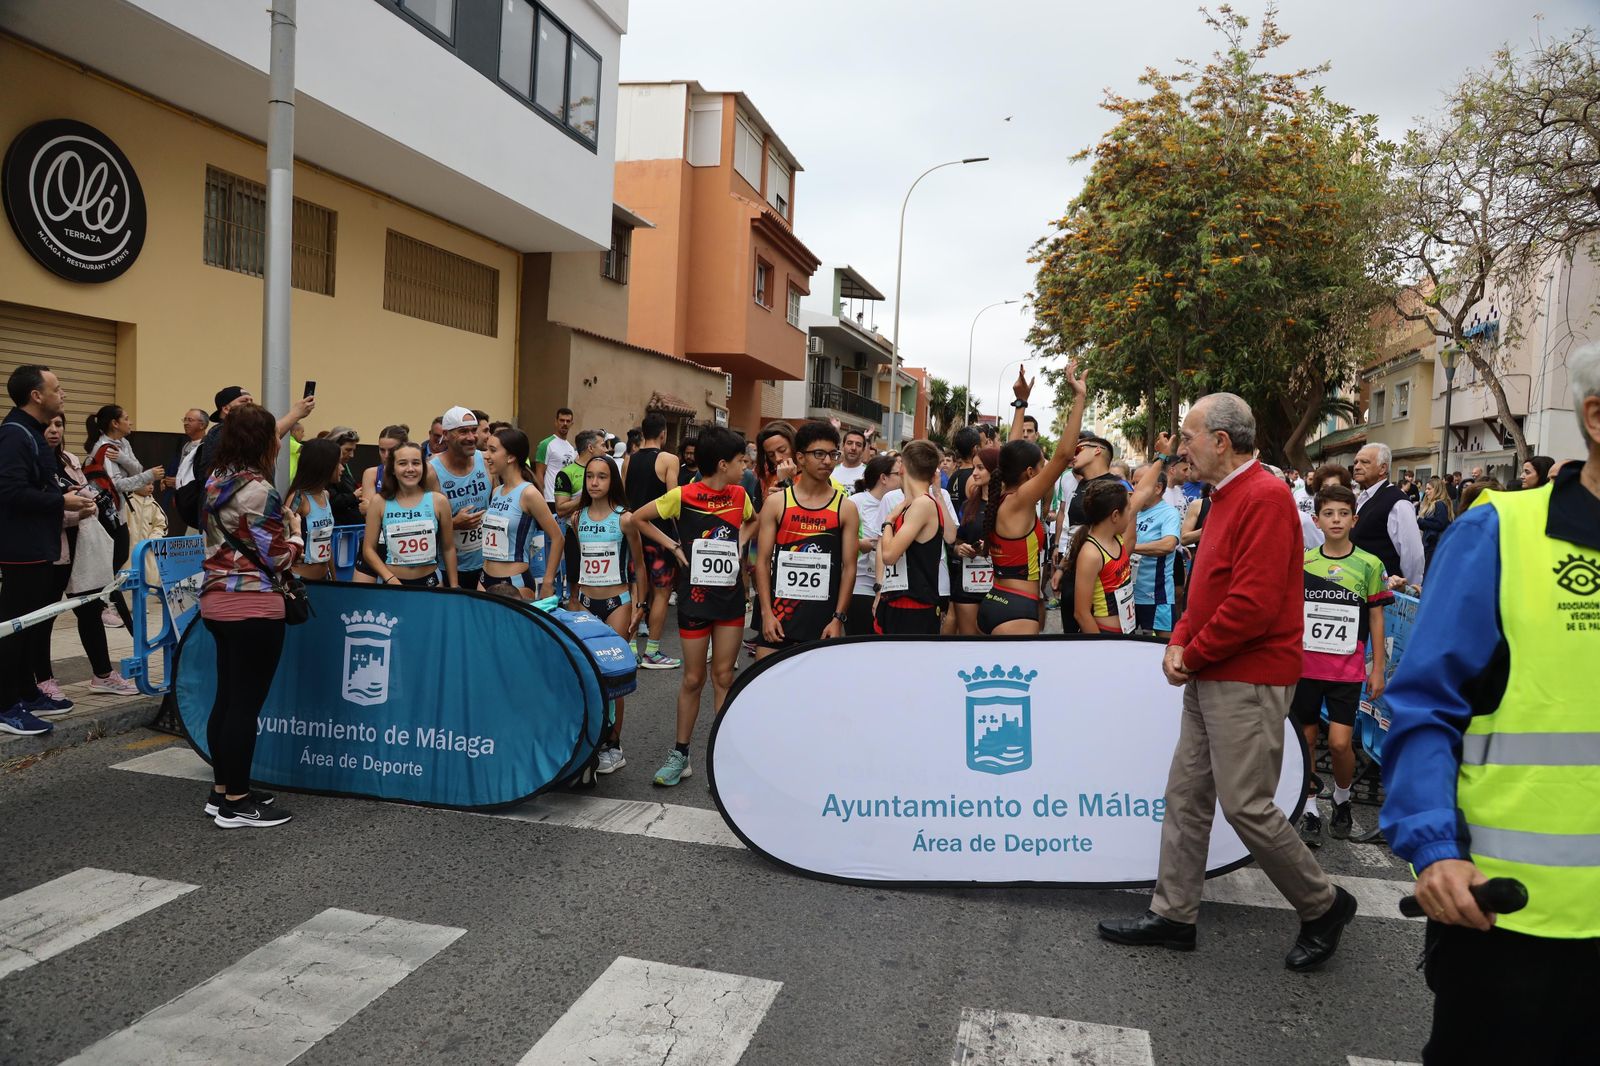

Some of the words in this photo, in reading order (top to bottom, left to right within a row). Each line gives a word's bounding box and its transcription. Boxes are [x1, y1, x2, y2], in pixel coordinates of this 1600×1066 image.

[43, 150, 118, 235] Olé
[64, 228, 101, 243] TERRAZA
[37, 230, 61, 257] MÁLAGA
[66, 257, 106, 270] RESTAURANT
[110, 249, 129, 266] EVENTS
[446, 480, 487, 499] nerja
[312, 517, 332, 527] nerja
[386, 509, 422, 519] nerja
[791, 514, 827, 525] Málaga
[154, 541, 167, 559] 44
[318, 544, 331, 558] 29
[397, 538, 429, 554] 296
[584, 559, 611, 574] 297
[702, 558, 733, 573] 900
[787, 571, 821, 588] 926
[971, 570, 994, 583] 127
[1304, 588, 1360, 601] tecnoaire
[1312, 622, 1347, 641] 674
[1567, 622, 1575, 631] DE
[1579, 622, 1587, 631] EL
[1589, 622, 1600, 631] PAL
[257, 716, 377, 743] yuntamiento
[384, 725, 410, 746] de
[416, 728, 495, 758] Málaga
[300, 746, 333, 767] Área
[339, 753, 357, 768] de
[363, 756, 423, 777] Deporte
[822, 794, 1022, 823] Ayuntamiento
[1033, 794, 1068, 818] de
[1079, 792, 1167, 823] Málag
[912, 829, 962, 852] Área
[969, 834, 996, 852] de
[1005, 834, 1093, 857] Deporte
